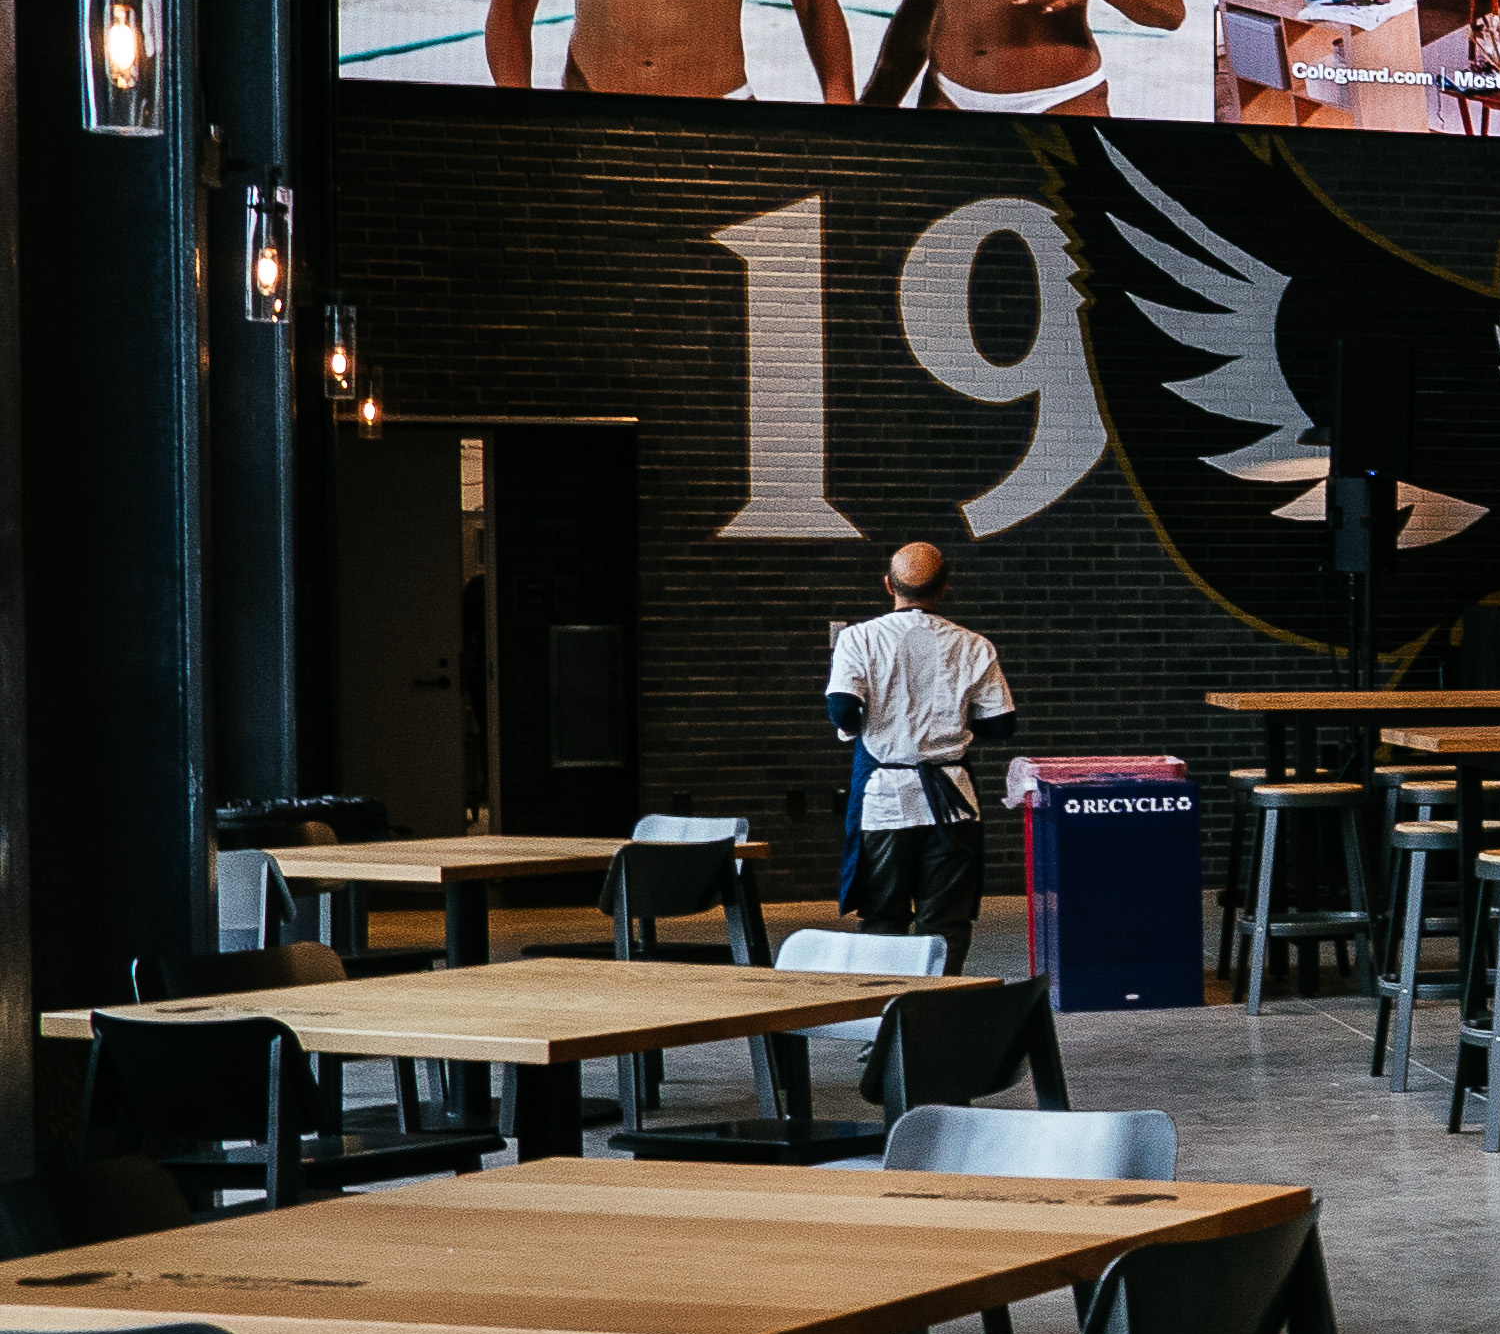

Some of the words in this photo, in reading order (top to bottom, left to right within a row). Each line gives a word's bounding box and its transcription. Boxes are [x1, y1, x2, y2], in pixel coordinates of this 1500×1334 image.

[1291, 62, 1434, 86] Cologuard.com
[712, 193, 1112, 541] 19
[1082, 796, 1175, 815] RECYCLE
